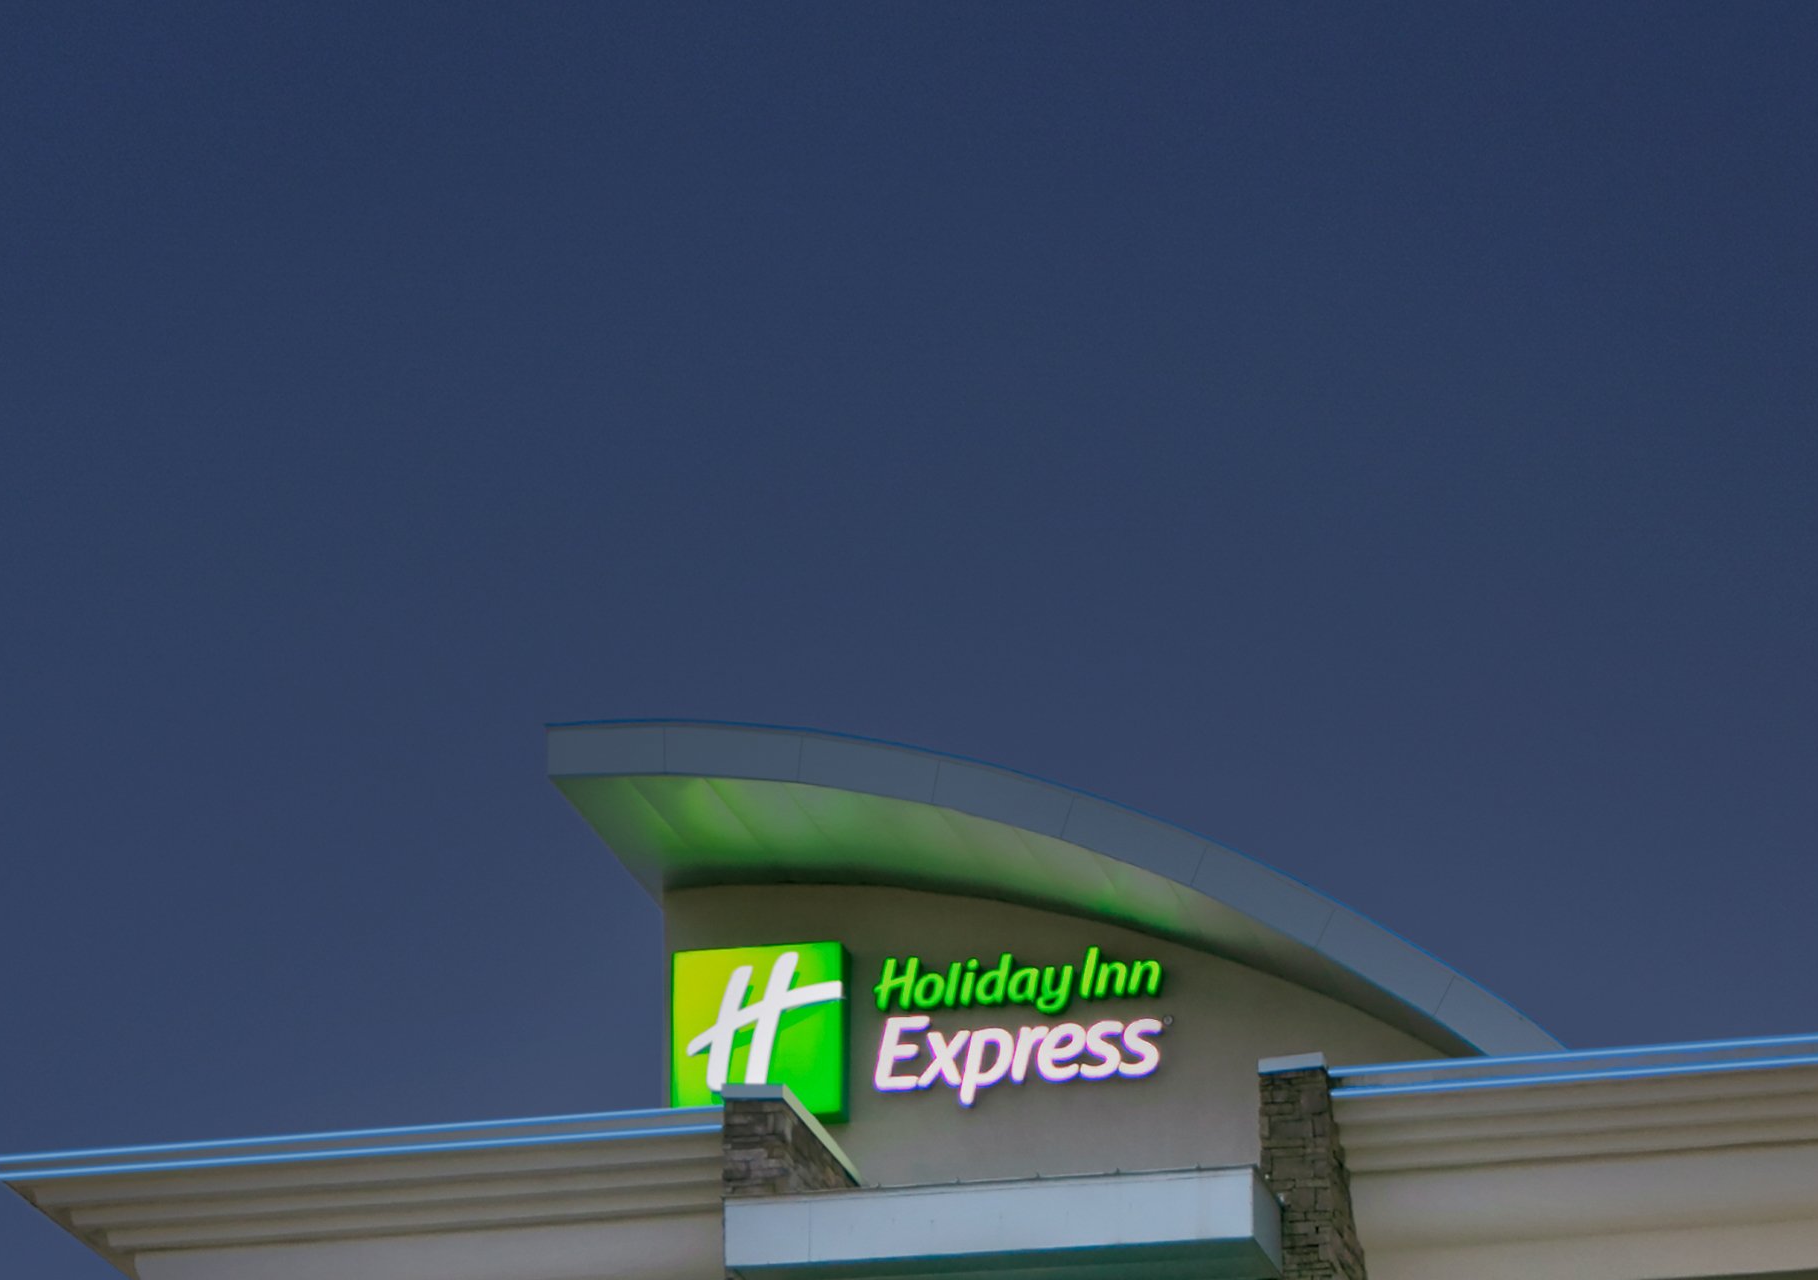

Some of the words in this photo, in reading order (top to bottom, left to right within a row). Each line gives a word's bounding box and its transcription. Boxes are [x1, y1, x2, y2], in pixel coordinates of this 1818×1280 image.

[874, 952, 1072, 1012] Holiday
[1081, 946, 1161, 999] Inn
[874, 1015, 1163, 1106] Express
